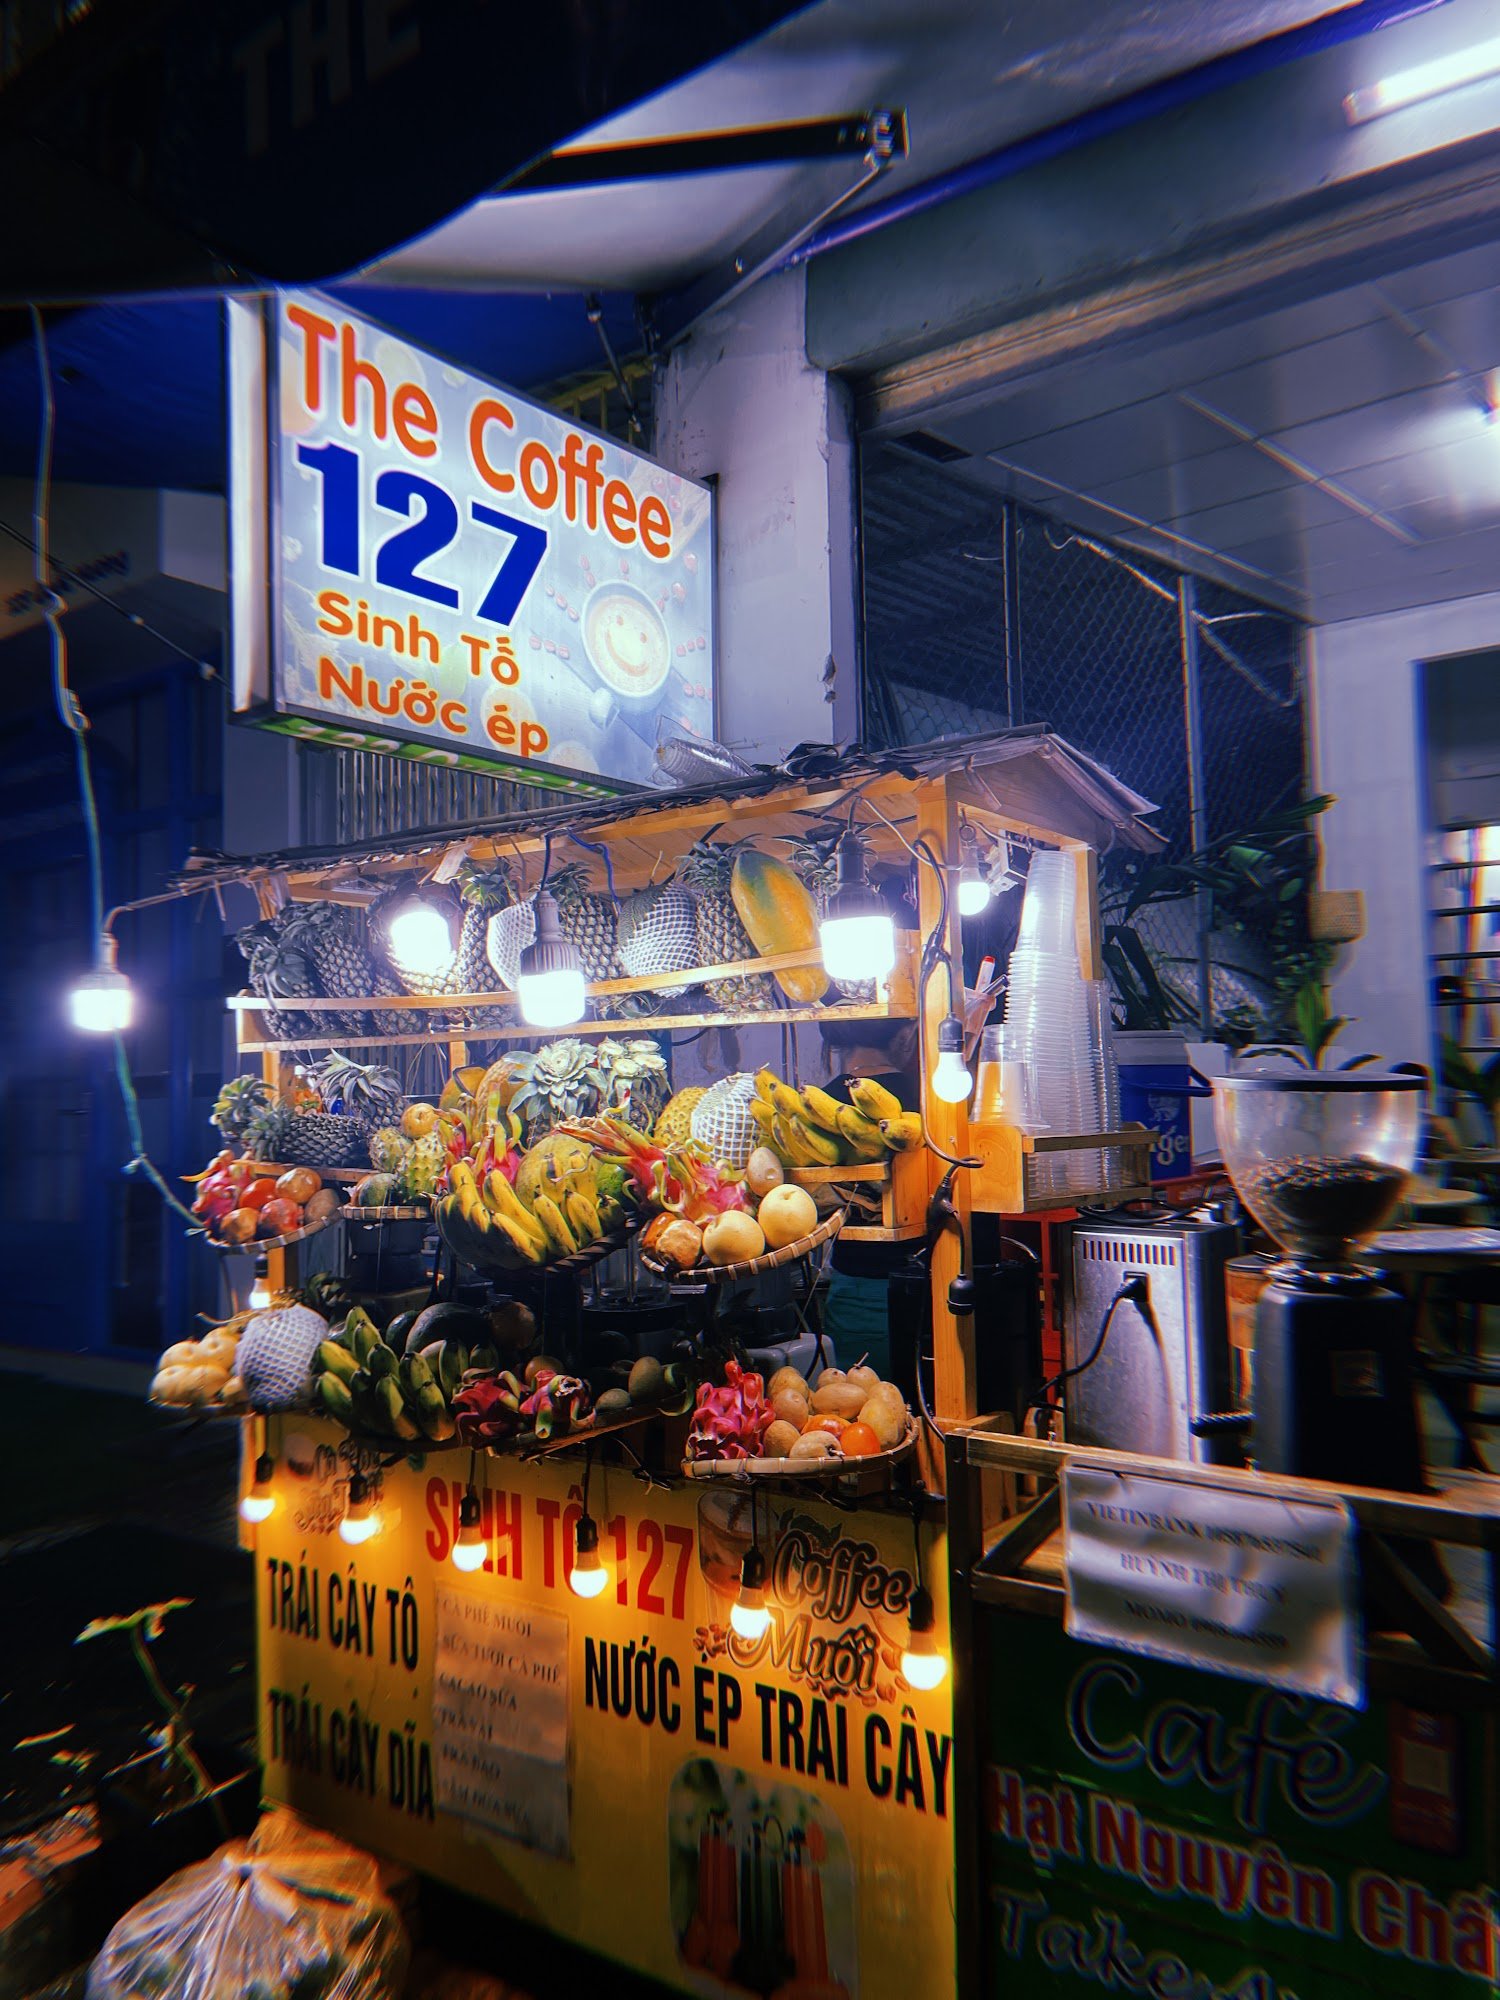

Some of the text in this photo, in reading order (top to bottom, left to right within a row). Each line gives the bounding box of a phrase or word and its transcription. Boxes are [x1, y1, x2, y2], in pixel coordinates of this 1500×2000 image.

[287, 302, 672, 559] The Coffee
[297, 441, 548, 627] 127
[318, 591, 440, 664] Sinh
[319, 656, 549, 759] Nước ép
[267, 1549, 320, 1642] TRÁI
[328, 1561, 377, 1659] CÂY
[607, 1514, 694, 1620] 127
[772, 1528, 912, 1625] Coffee
[268, 1682, 322, 1776] TRÁI
[330, 1699, 379, 1799] CÂY
[584, 1635, 682, 1734] NƯỚC
[693, 1652, 743, 1750] ÉP
[864, 1704, 954, 1819] CÂY
[1065, 1657, 1388, 1834] Café
[984, 1763, 1500, 1986] Hạt Nguyên Chấ
[992, 1884, 1195, 2000] Take
